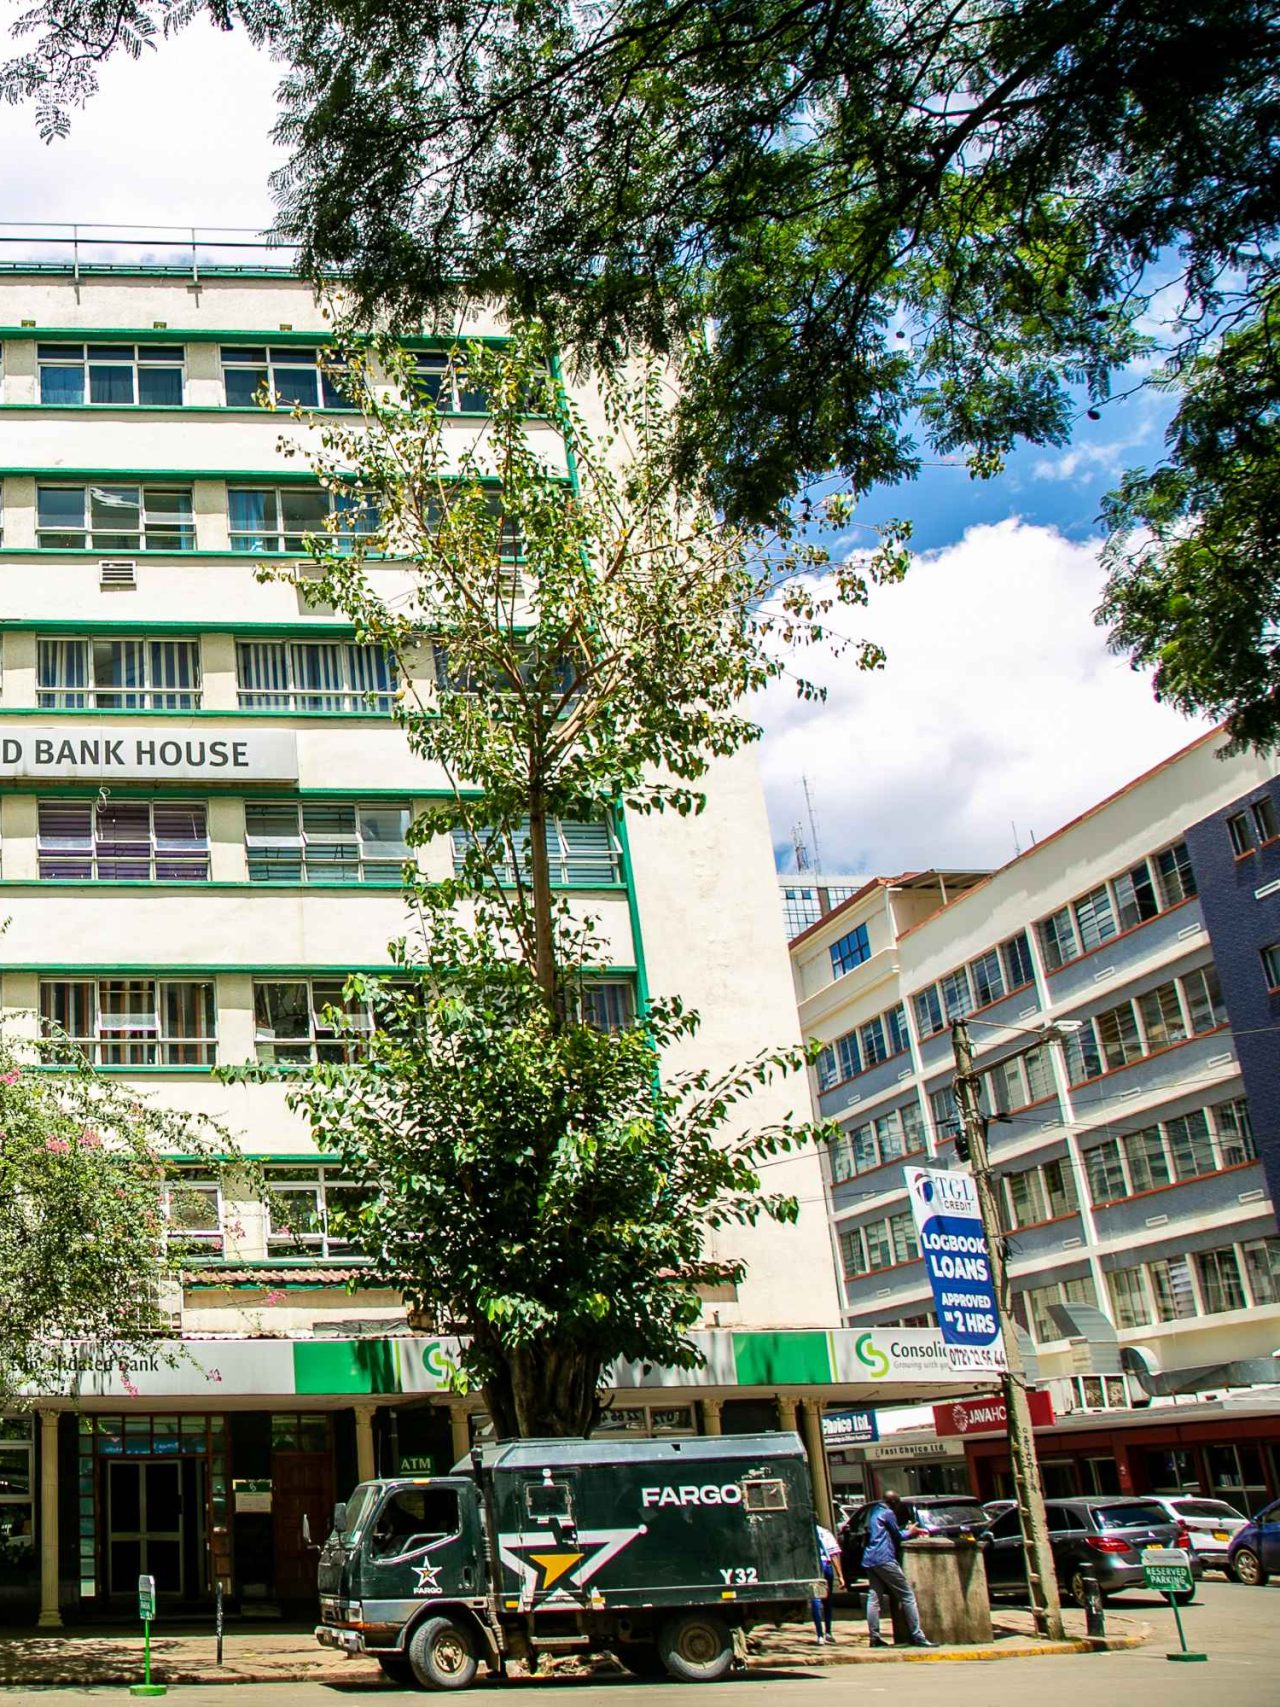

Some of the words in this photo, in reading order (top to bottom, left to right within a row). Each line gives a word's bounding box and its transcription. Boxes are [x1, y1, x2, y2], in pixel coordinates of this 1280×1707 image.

[35, 740, 125, 766] BANK
[137, 741, 250, 768] HOUSE
[935, 1177, 974, 1201] TGL
[944, 1200, 972, 1211] CREDIT
[923, 1232, 986, 1253] LOGBOOK
[931, 1255, 988, 1282] LOANS
[941, 1293, 991, 1309] APPROVED
[954, 1311, 965, 1332] 2
[966, 1313, 996, 1334] HRS
[880, 1448, 898, 1456] Fast
[899, 1445, 928, 1455] Choice
[401, 1458, 431, 1470] ATM
[642, 1484, 742, 1507] FARGO
[1145, 1567, 1187, 1577] RESERVED
[1150, 1575, 1186, 1585] PARKING
[413, 1587, 443, 1595] FARGO
